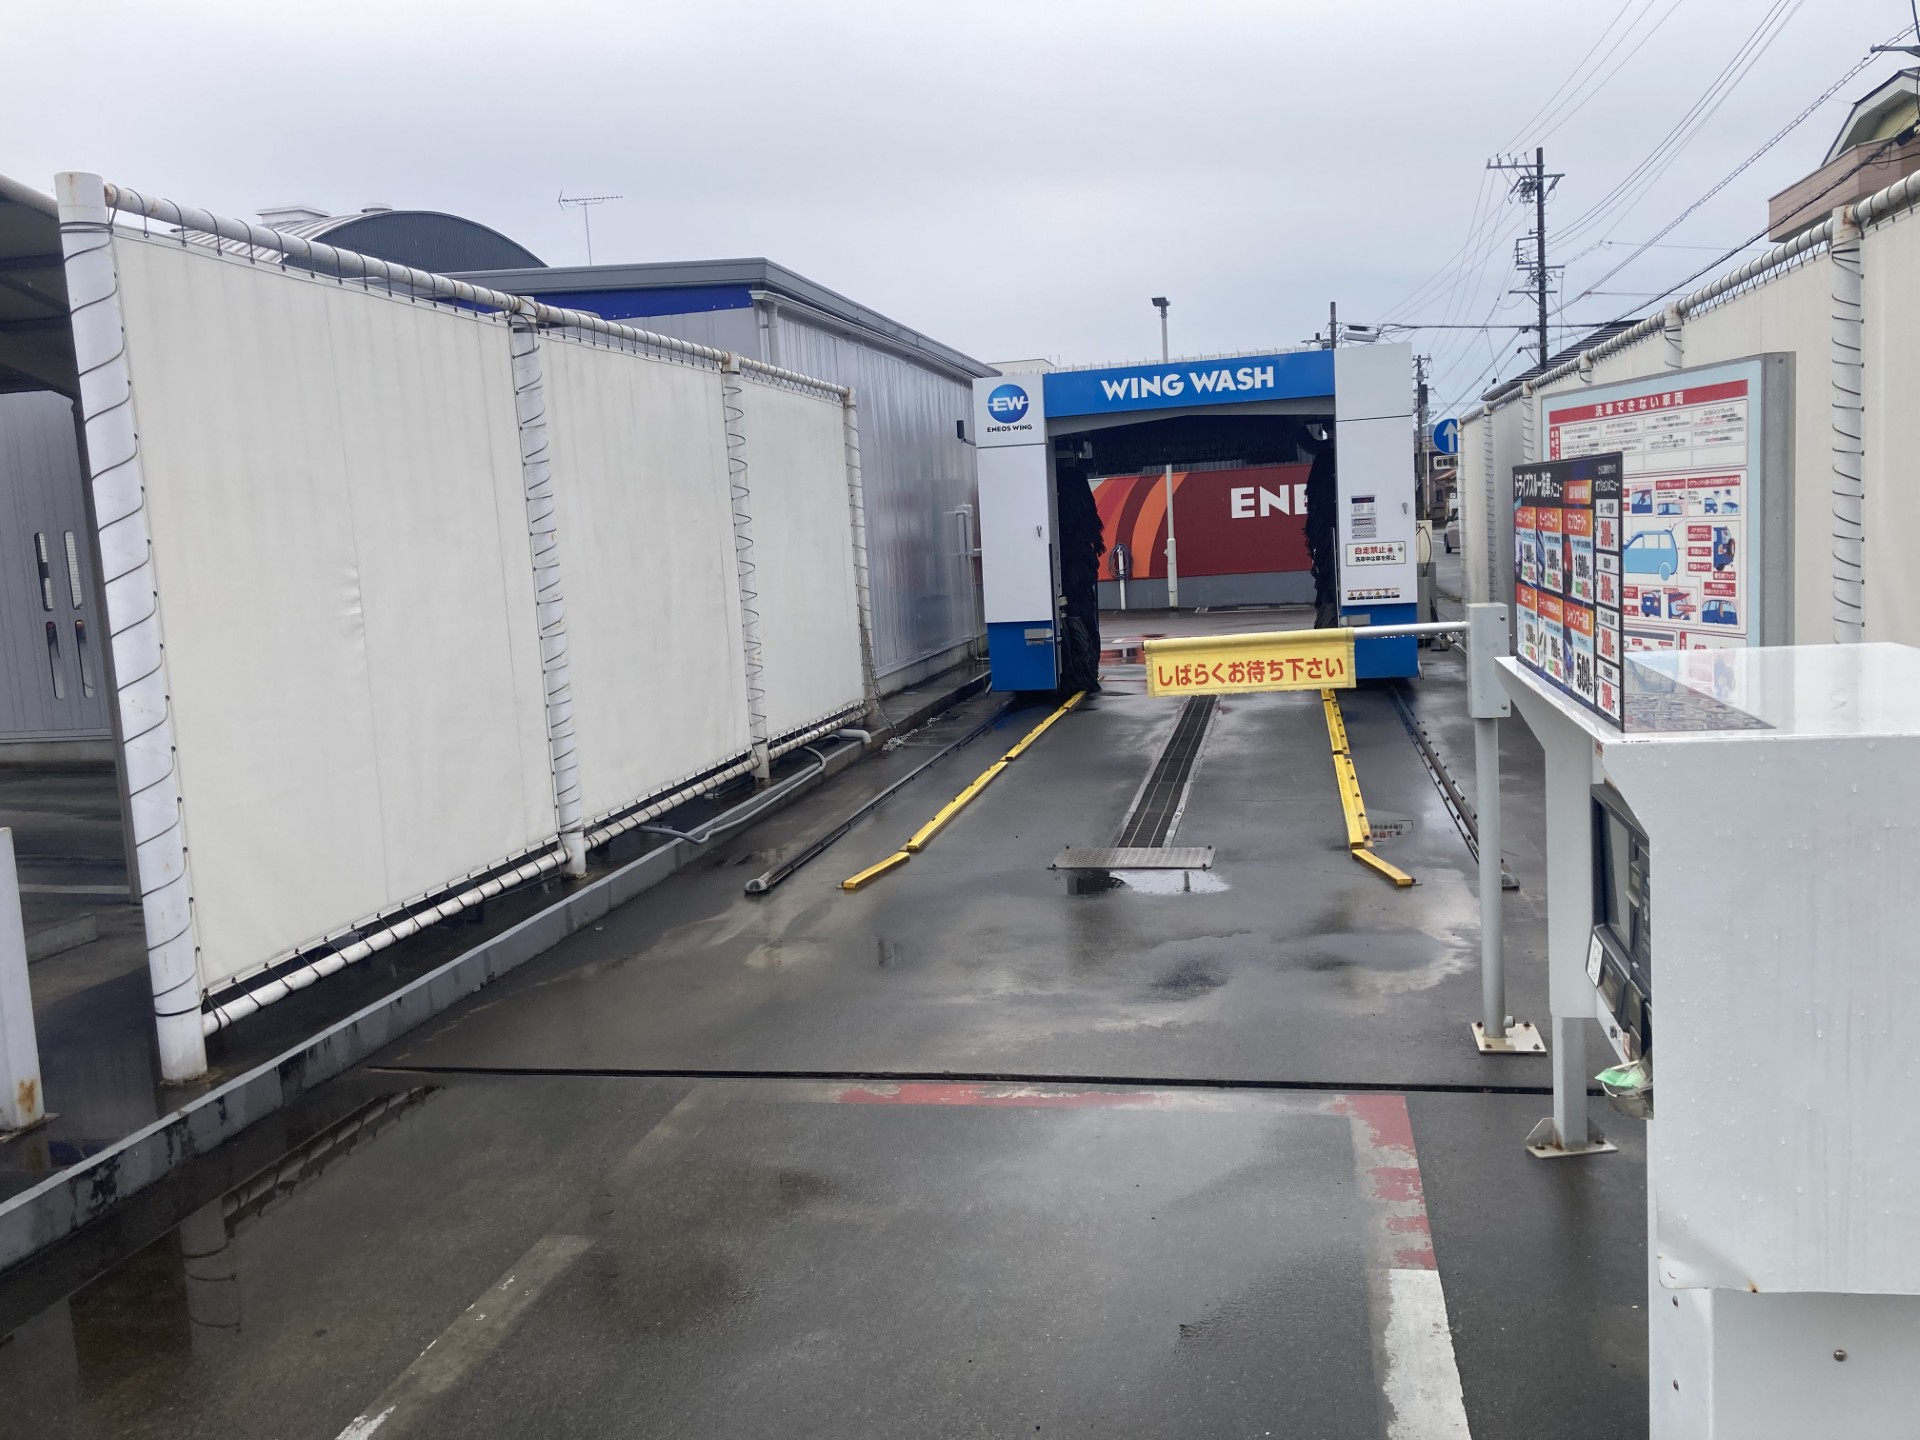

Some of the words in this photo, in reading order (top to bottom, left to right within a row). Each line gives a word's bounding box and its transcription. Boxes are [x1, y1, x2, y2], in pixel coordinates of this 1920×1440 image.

[1101, 374, 1185, 401] WING
[1189, 365, 1274, 394] WASH
[993, 396, 1025, 411] EW
[1594, 391, 1684, 417] 洗車できない車両
[986, 425, 1011, 433] ENEOS
[1354, 546, 1386, 555] 自走禁止
[1158, 657, 1345, 687] しばらくお待ち下さい
